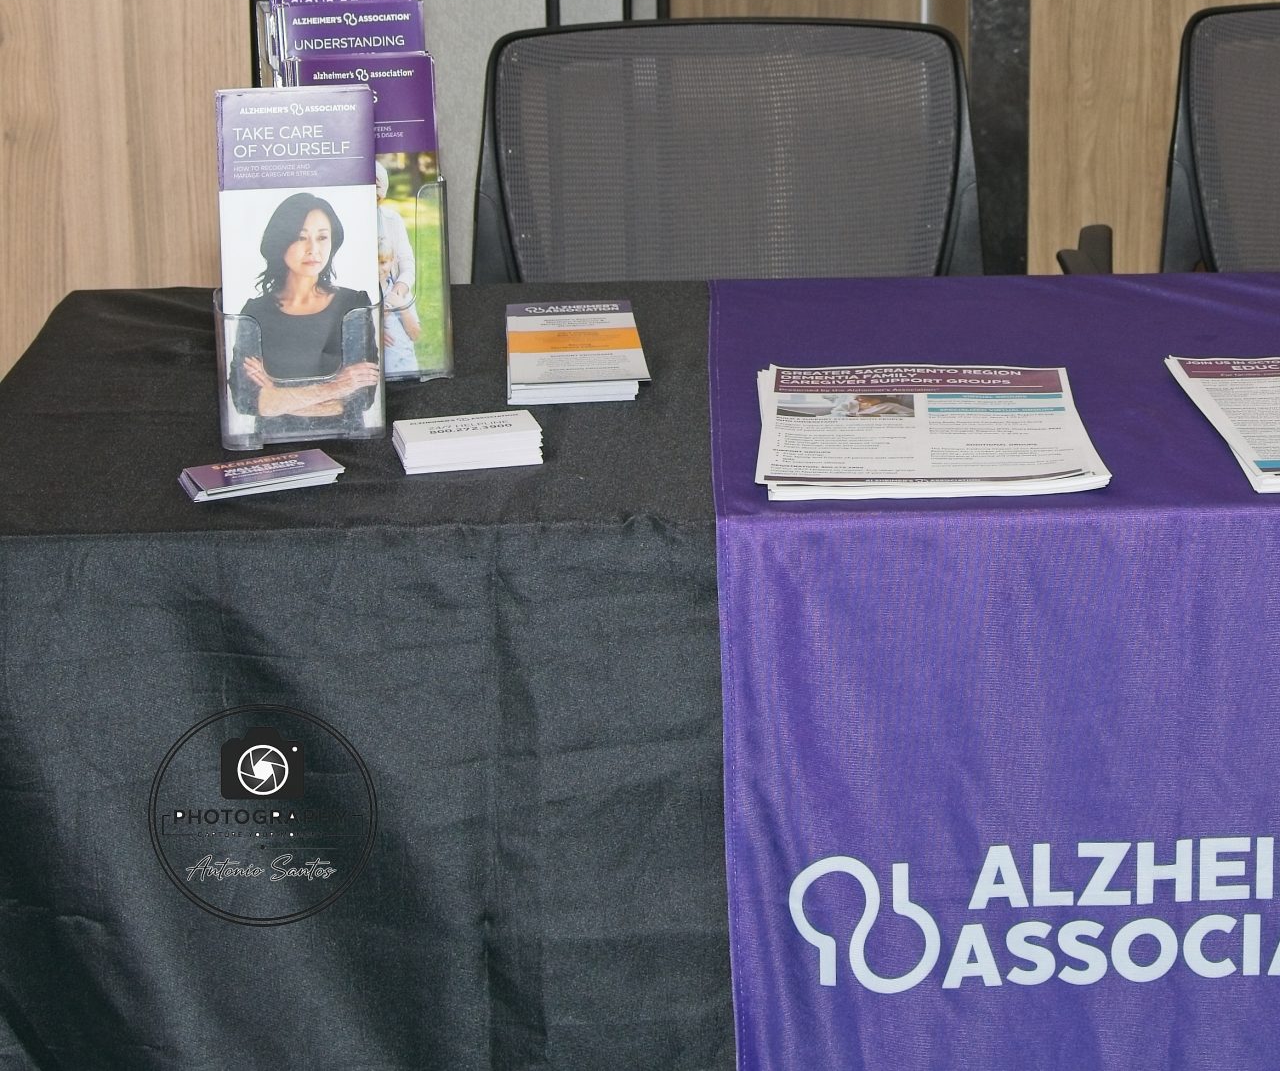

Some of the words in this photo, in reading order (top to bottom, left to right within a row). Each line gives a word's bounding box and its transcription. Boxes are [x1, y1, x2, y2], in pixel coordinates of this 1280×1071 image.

[292, 15, 342, 25] ALZHEIMER'S
[358, 13, 410, 23] ASSOCIATION
[294, 35, 405, 51] UNDERSTANDING
[312, 70, 354, 81] alzheimer's
[370, 68, 414, 78] association
[239, 107, 288, 115] ALZHEIMER'S
[304, 104, 356, 113] ASSOCIATION
[232, 127, 274, 141] TAKE
[278, 125, 324, 141] CARE
[233, 143, 257, 159] OF
[262, 141, 350, 157] YOURSELF
[429, 423, 512, 435] 800.272.3900
[211, 453, 299, 470] SACRAMENTO
